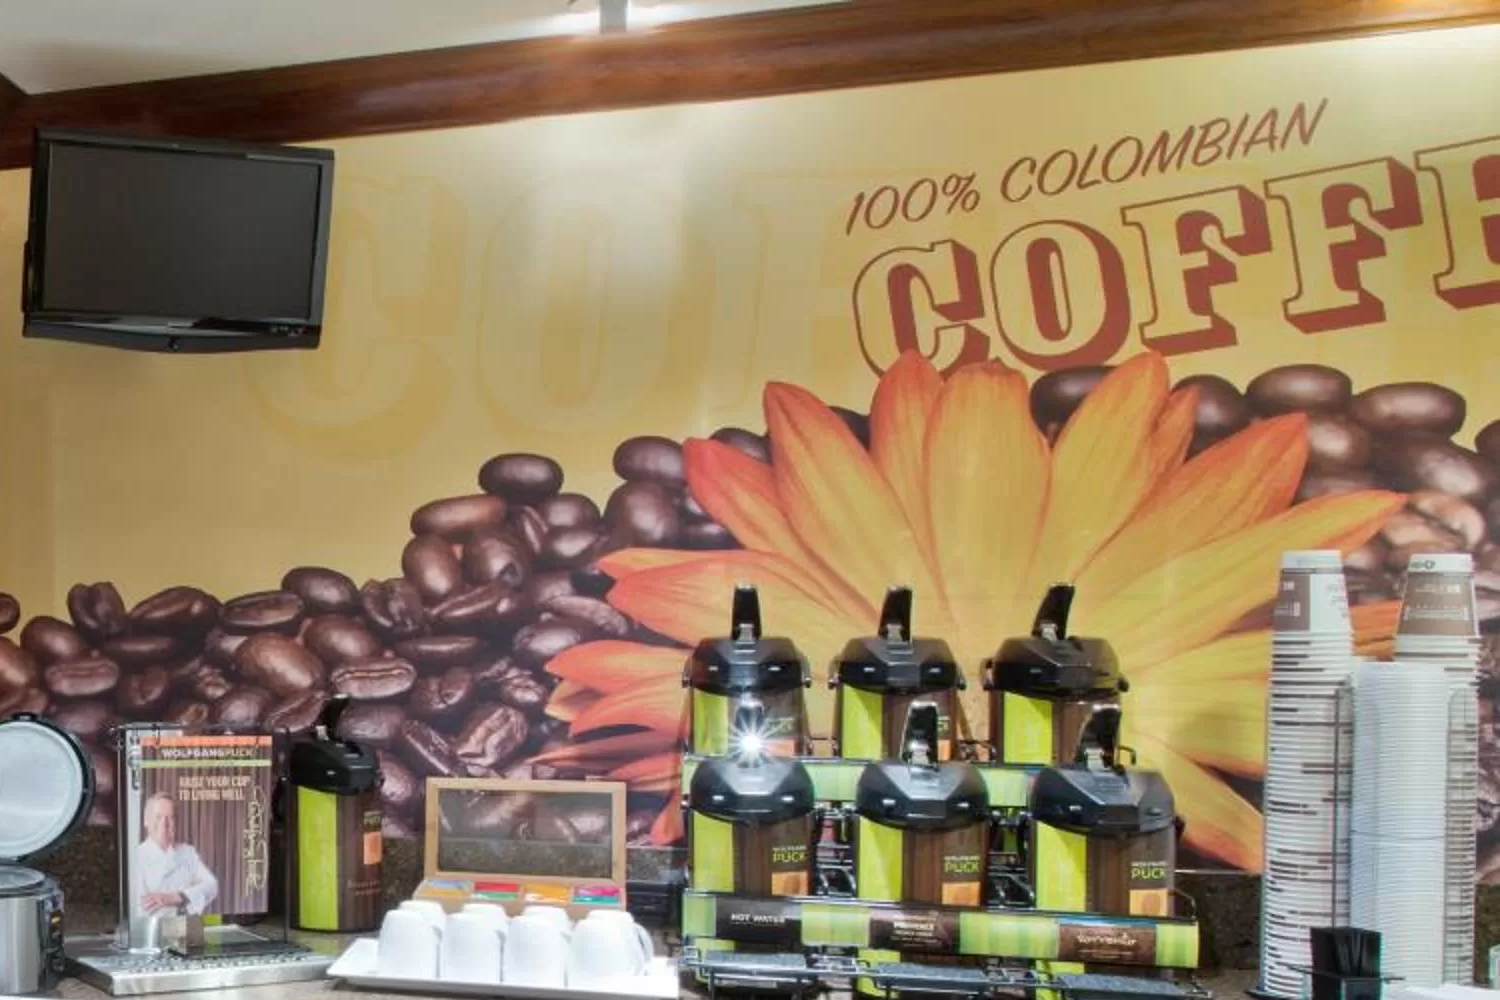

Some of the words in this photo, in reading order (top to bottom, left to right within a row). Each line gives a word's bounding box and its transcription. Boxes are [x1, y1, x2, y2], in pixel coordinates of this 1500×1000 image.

[844, 173, 981, 237] 100%
[999, 97, 1329, 203] COLOMBIAN
[943, 861, 980, 873] PUCK
[1130, 867, 1166, 880] PUCK
